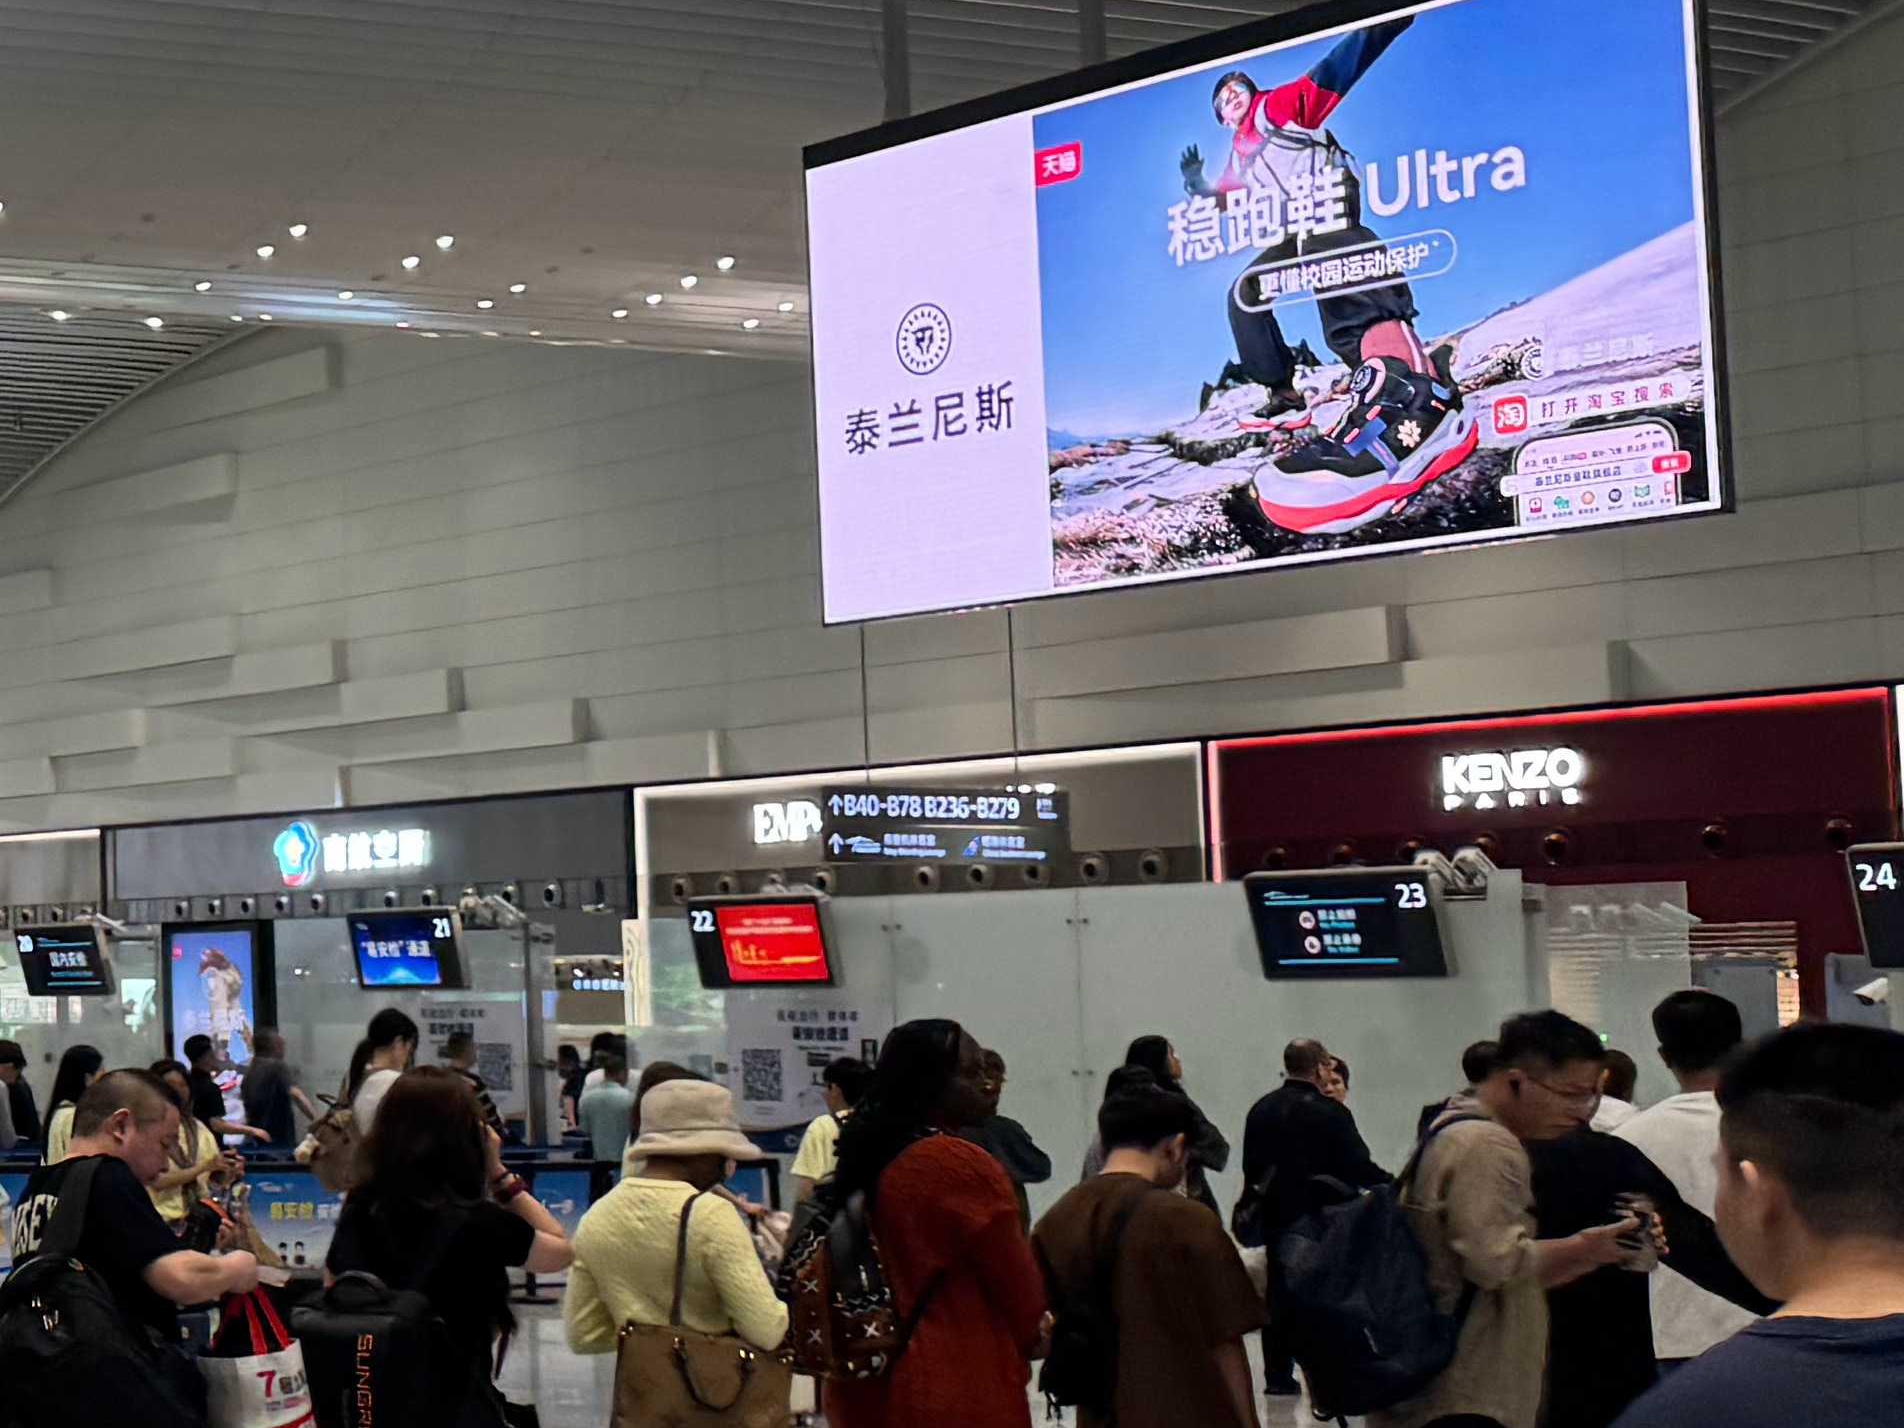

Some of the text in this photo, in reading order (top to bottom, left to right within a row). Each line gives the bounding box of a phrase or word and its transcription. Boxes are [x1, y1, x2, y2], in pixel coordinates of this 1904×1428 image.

[1167, 146, 1527, 267] 稳跑鞋 Ultra
[1541, 382, 1674, 418] 打开淘宝搜索
[845, 380, 1014, 455] 泰兰尼斯
[1442, 747, 1581, 794] KENZO
[1443, 787, 1581, 812] PARIS
[1855, 862, 1897, 891] 24
[1394, 882, 1427, 909] 23
[432, 918, 451, 938] 21
[690, 910, 716, 933] 22
